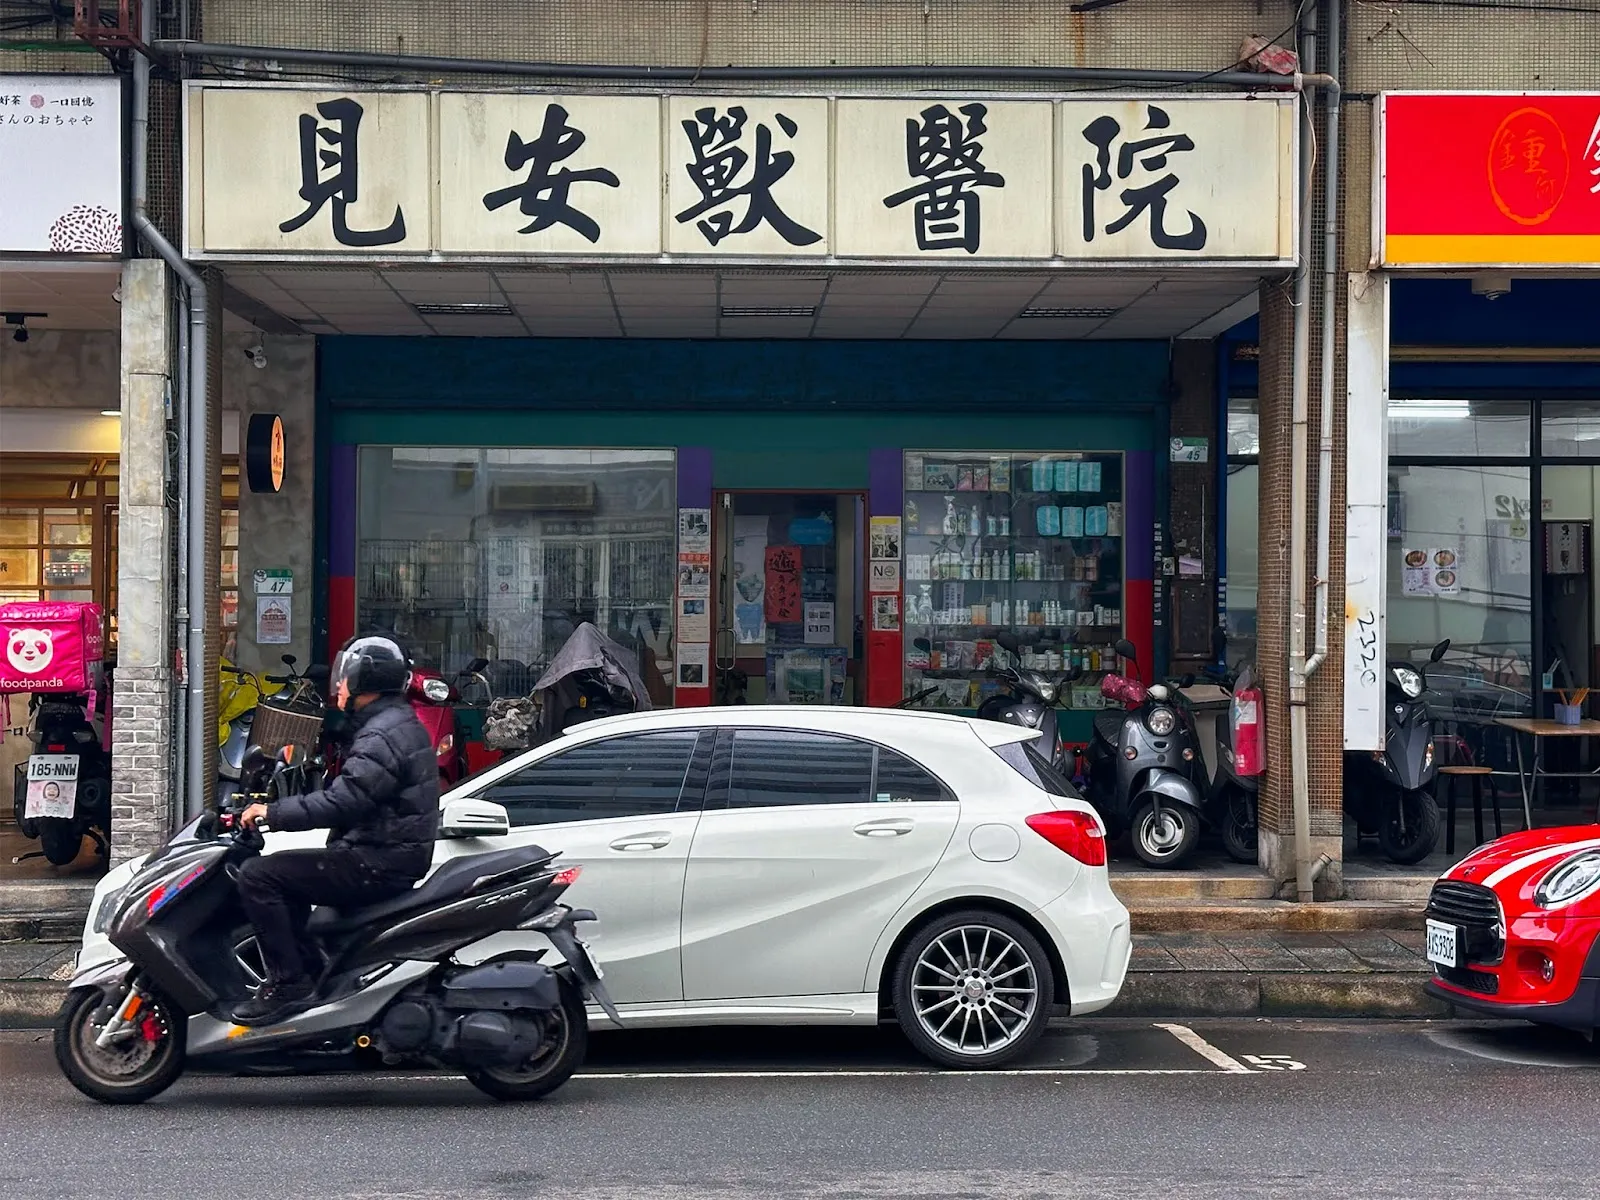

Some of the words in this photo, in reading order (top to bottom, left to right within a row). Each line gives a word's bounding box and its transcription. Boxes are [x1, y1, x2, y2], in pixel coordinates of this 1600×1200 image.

[50, 95, 95, 107] 一口回憶
[278, 97, 1207, 254] 見安獸醫院
[1186, 450, 1201, 461] 45
[270, 581, 286, 593] 47
[0, 677, 64, 689] foodpanda
[31, 763, 77, 776] 185-NNW
